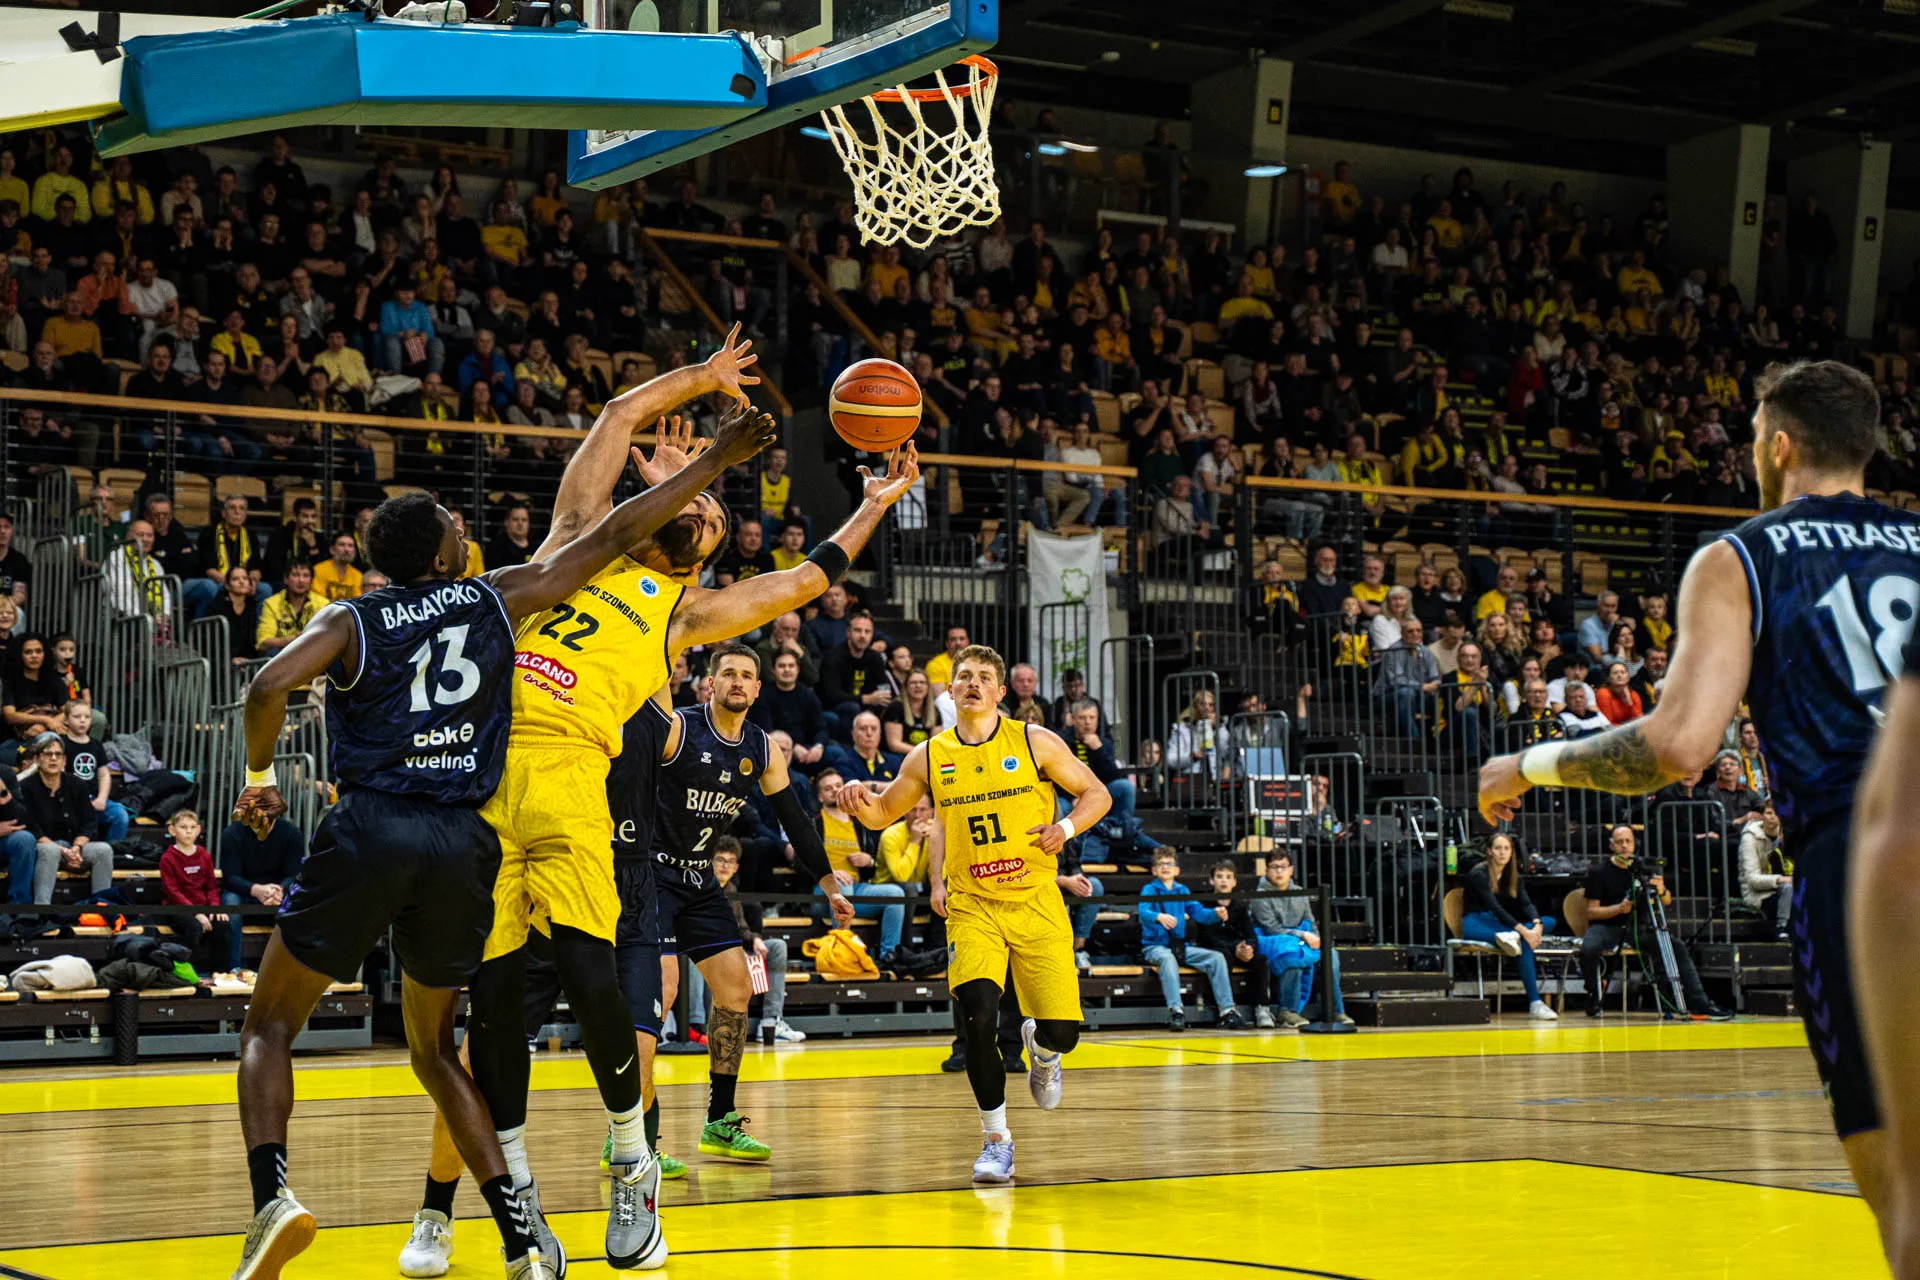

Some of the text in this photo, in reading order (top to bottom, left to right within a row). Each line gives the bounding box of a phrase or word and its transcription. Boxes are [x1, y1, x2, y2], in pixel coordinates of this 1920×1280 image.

[859, 384, 901, 396] molten
[1765, 521, 1920, 554] PETRASE
[381, 584, 481, 630] BAGAYOKO
[599, 590, 651, 636] SZOMBATHELY
[539, 602, 600, 651] 22
[1815, 574, 1920, 691] 18
[408, 624, 481, 712] 13
[523, 673, 575, 706] energia
[405, 747, 479, 772] vueling
[692, 827, 714, 852] 2
[967, 813, 1008, 847] 51
